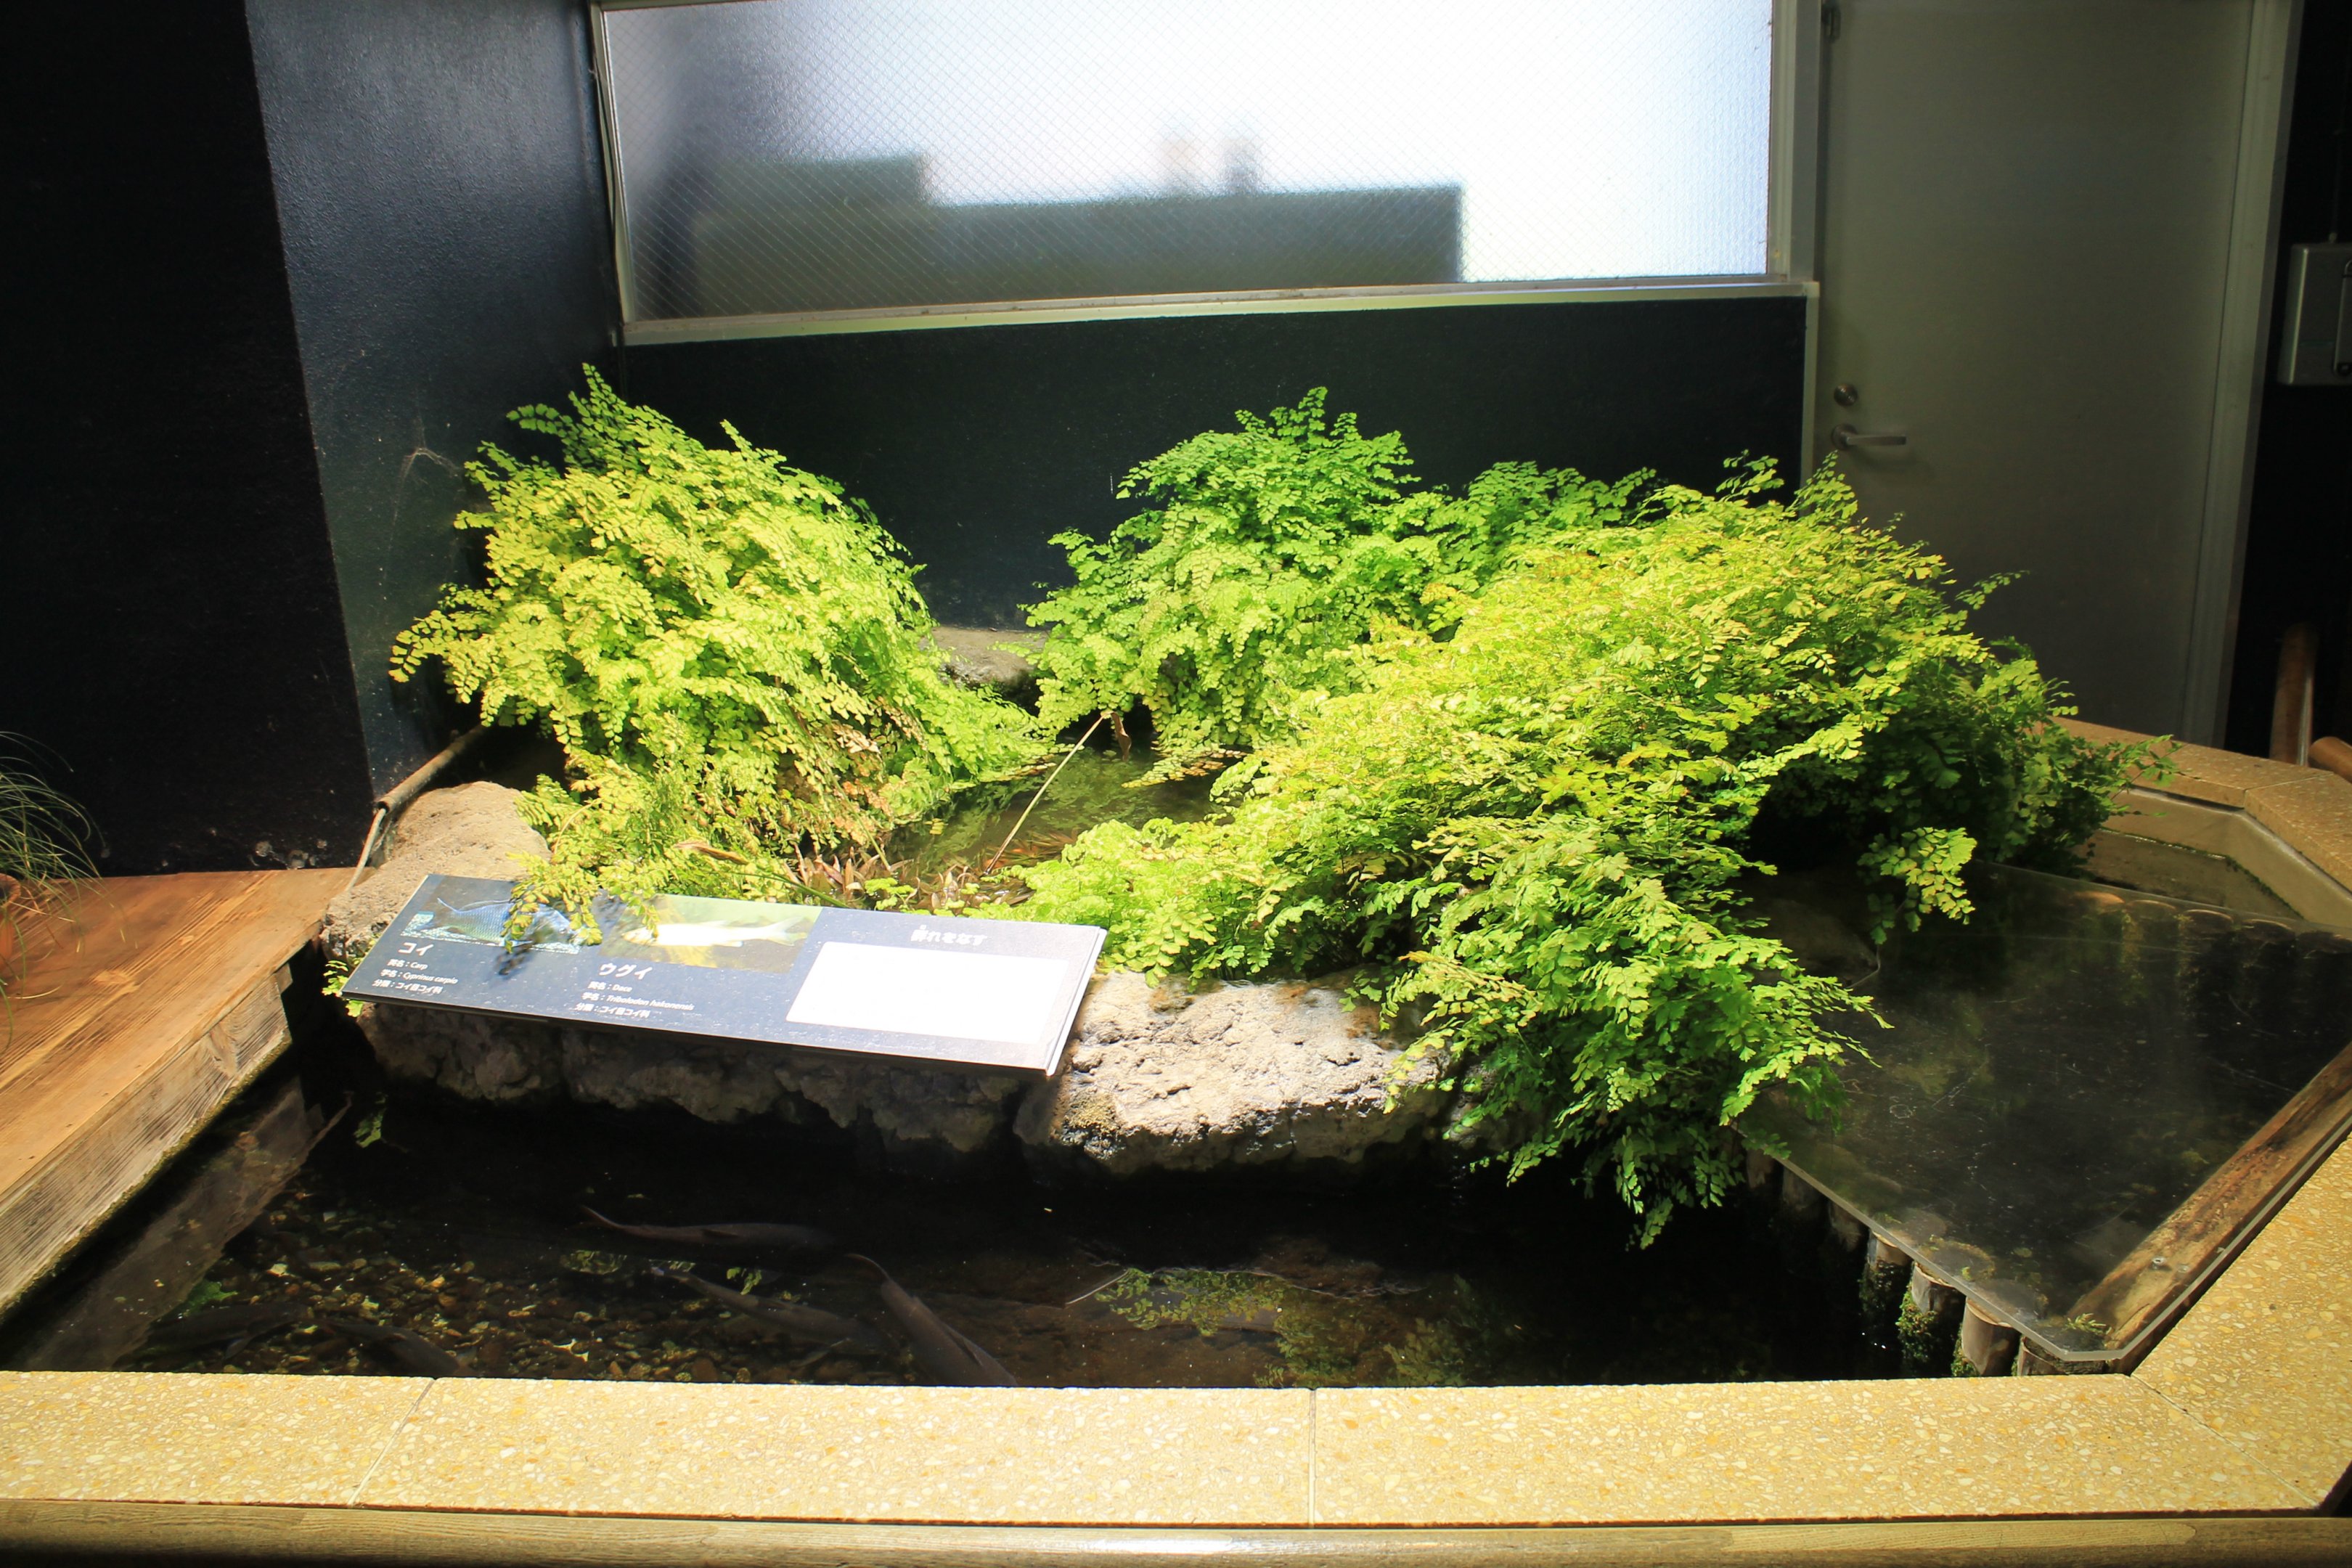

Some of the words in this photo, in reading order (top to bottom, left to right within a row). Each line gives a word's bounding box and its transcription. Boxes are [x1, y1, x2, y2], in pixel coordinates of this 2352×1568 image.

[398, 942, 434, 956] コイ
[598, 963, 653, 980] ウグイ
